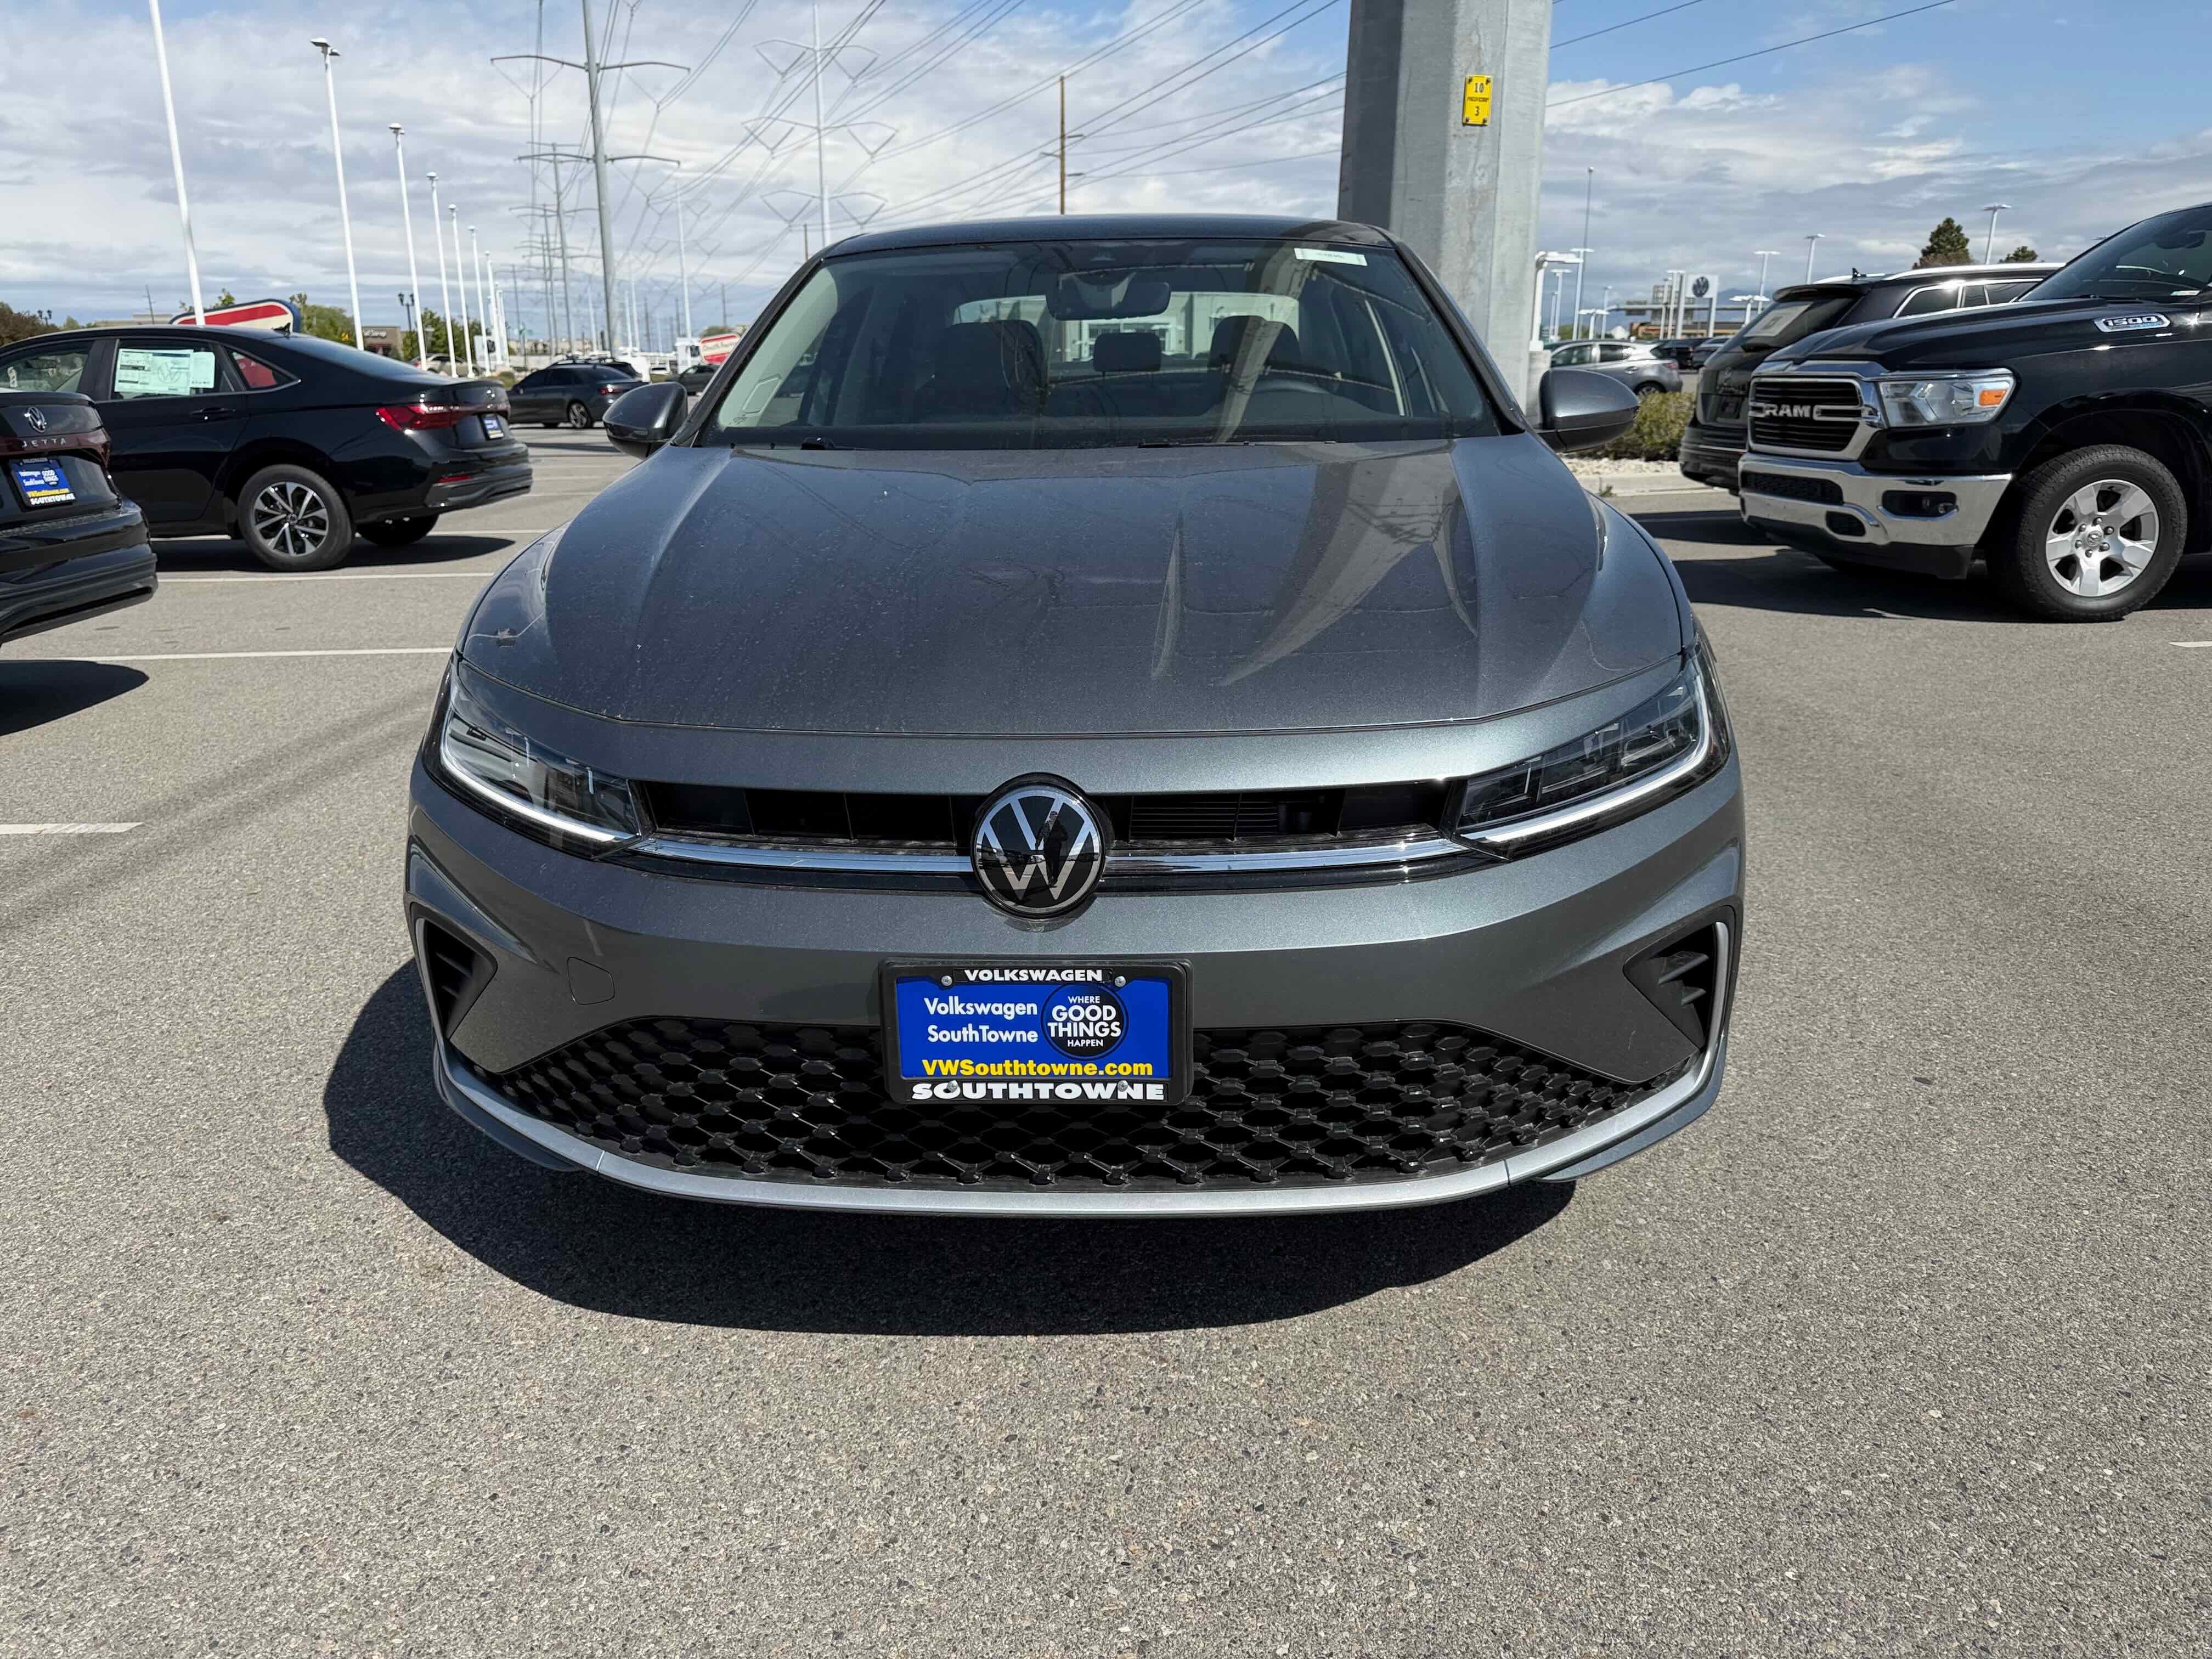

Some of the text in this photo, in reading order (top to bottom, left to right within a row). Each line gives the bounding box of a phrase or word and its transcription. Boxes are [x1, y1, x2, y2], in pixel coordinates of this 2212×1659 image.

[1474, 83, 1484, 93] 10
[1474, 105, 1480, 116] 3
[2105, 316, 2158, 326] 1500
[1764, 403, 1810, 417] RAM
[22, 438, 66, 447] JETTA
[964, 969, 1102, 981] VOLKSWAGEN
[1068, 996, 1100, 1004] WHERE
[923, 996, 1038, 1020] Volkswagen
[1052, 1005, 1116, 1022] GOOD
[927, 1023, 1039, 1042] SouthTowne
[1047, 1022, 1121, 1037] THINGS
[1067, 1039, 1104, 1047] HAPPEN
[922, 1059, 1153, 1076] VWSouthtowne.com
[911, 1081, 1164, 1100] SOUTHTOWNE
